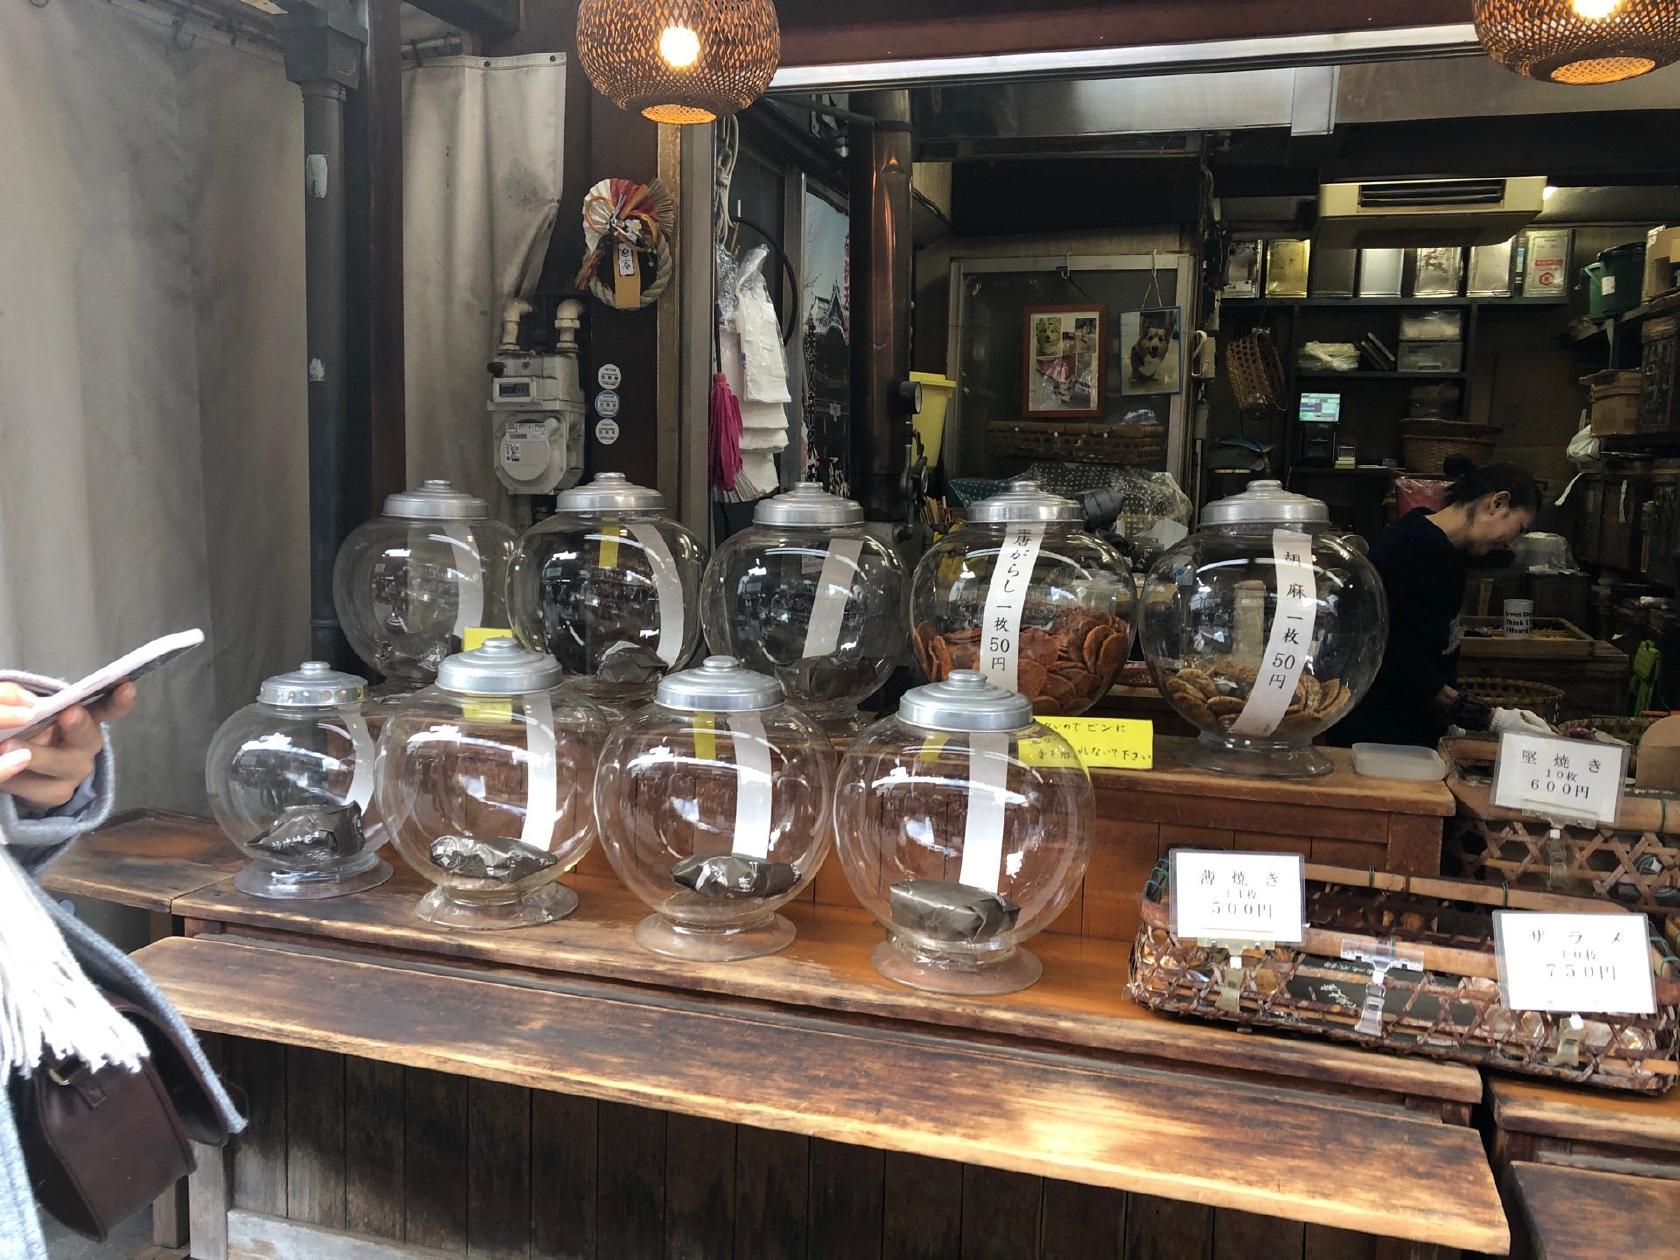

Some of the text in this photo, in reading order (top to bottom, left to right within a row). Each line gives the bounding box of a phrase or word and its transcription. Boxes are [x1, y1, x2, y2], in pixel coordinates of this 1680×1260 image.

[1268, 551, 1306, 689] 胡麻一枚50円
[1521, 749, 1601, 774] 堅焼き
[1530, 779, 1590, 800] 600円
[1211, 901, 1273, 918] 500円
[1546, 963, 1617, 981] 750円
